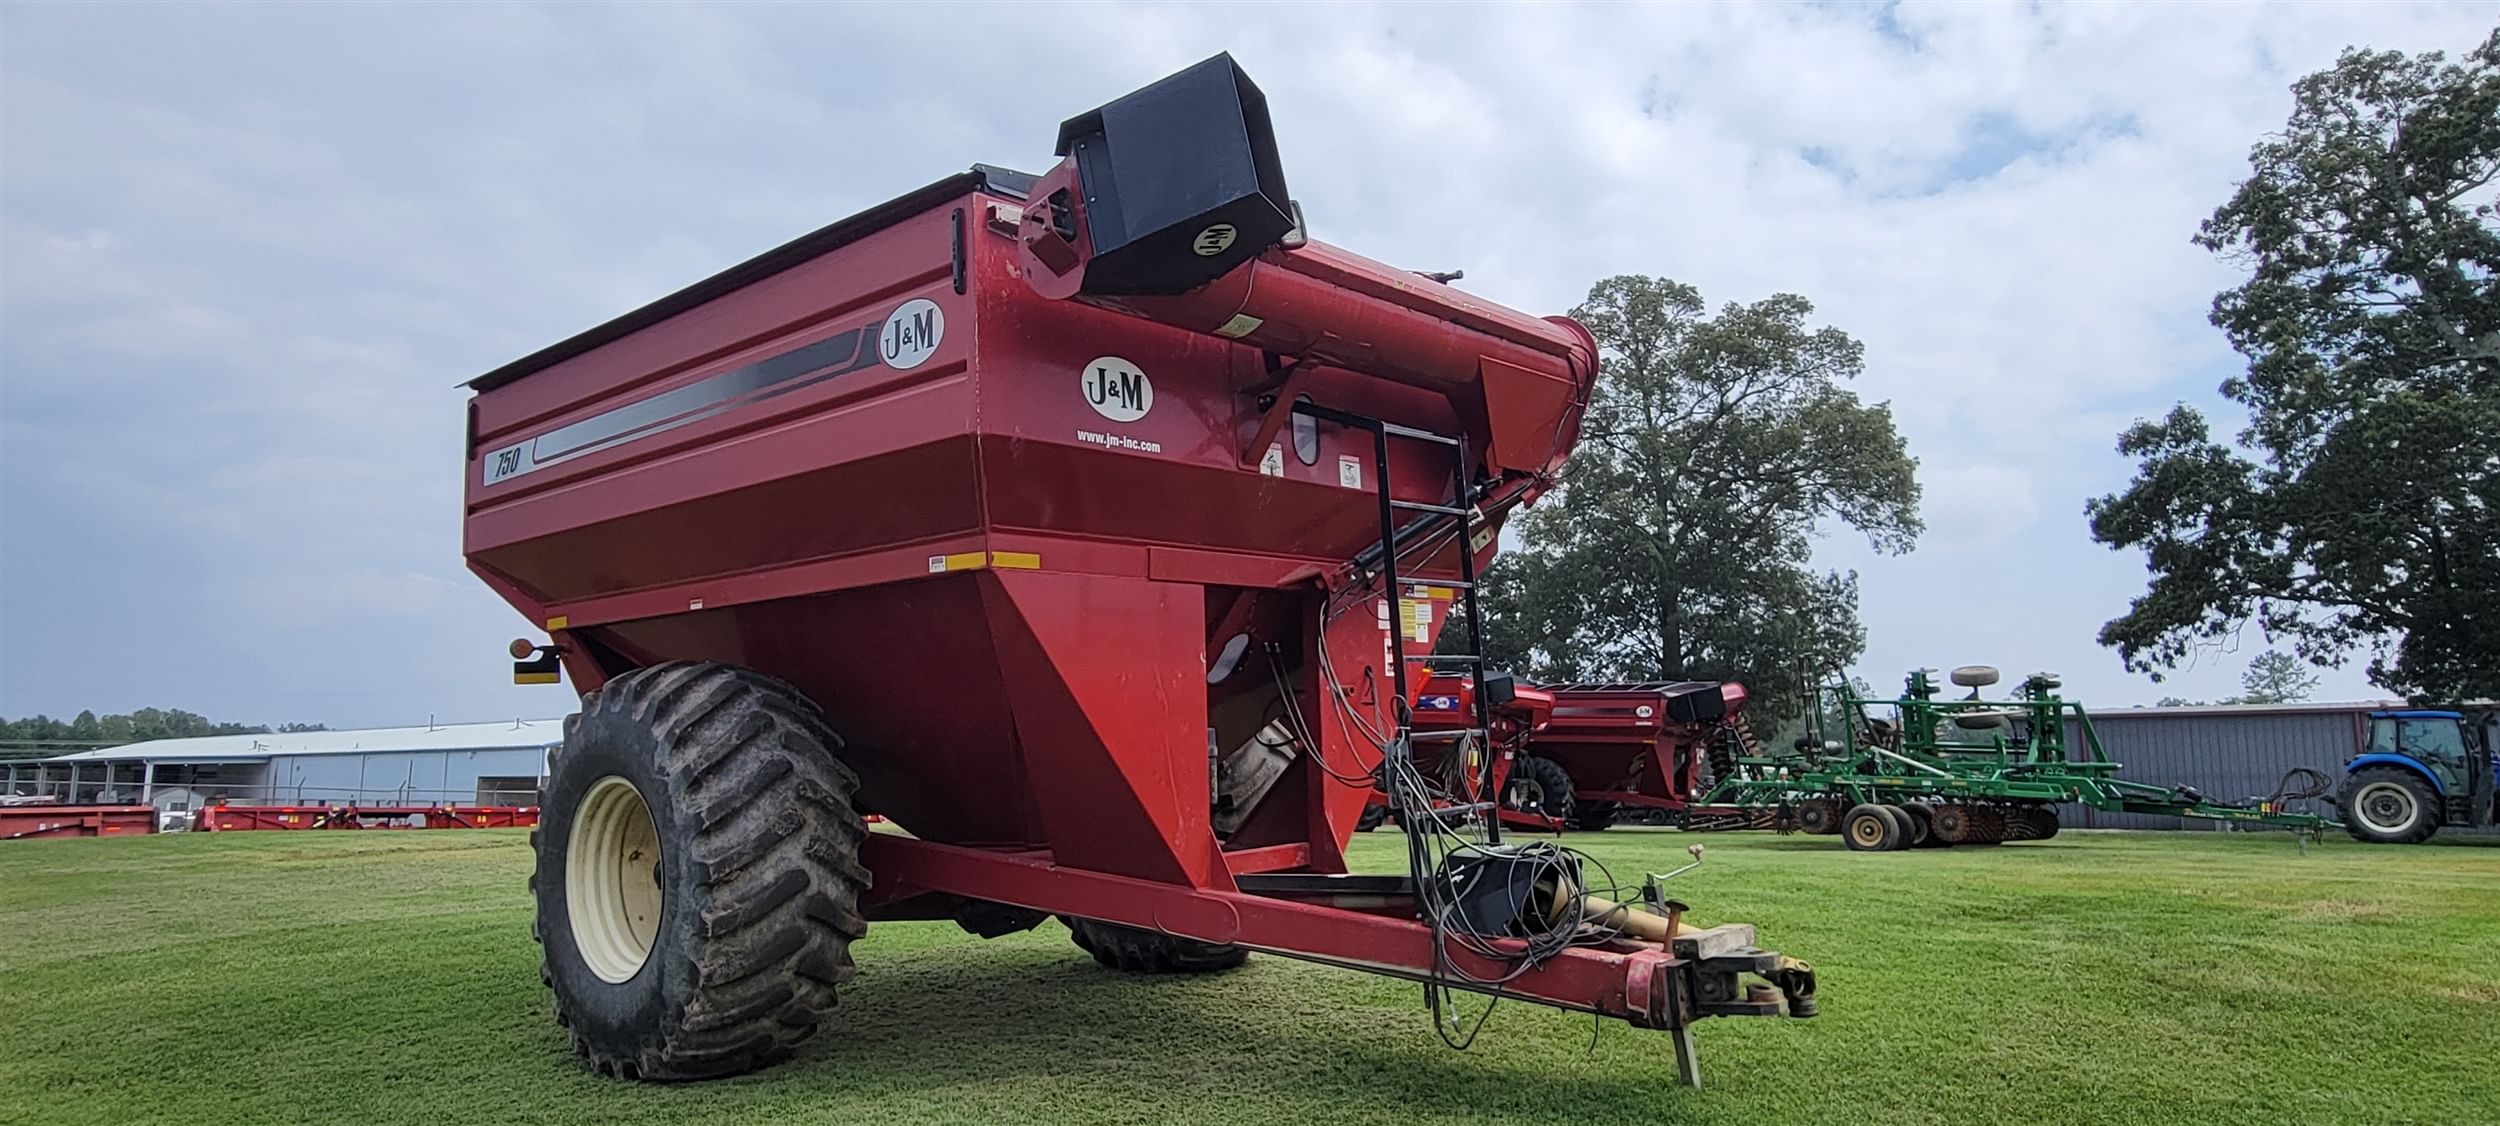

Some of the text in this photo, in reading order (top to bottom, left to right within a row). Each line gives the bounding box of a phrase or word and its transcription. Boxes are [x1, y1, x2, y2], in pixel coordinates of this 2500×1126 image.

[1199, 227, 1233, 254] J&M
[884, 308, 934, 360] J&M
[1086, 367, 1144, 412] J&M
[1076, 430, 1161, 453] www.jm-inc.com
[494, 447, 521, 478] 750
